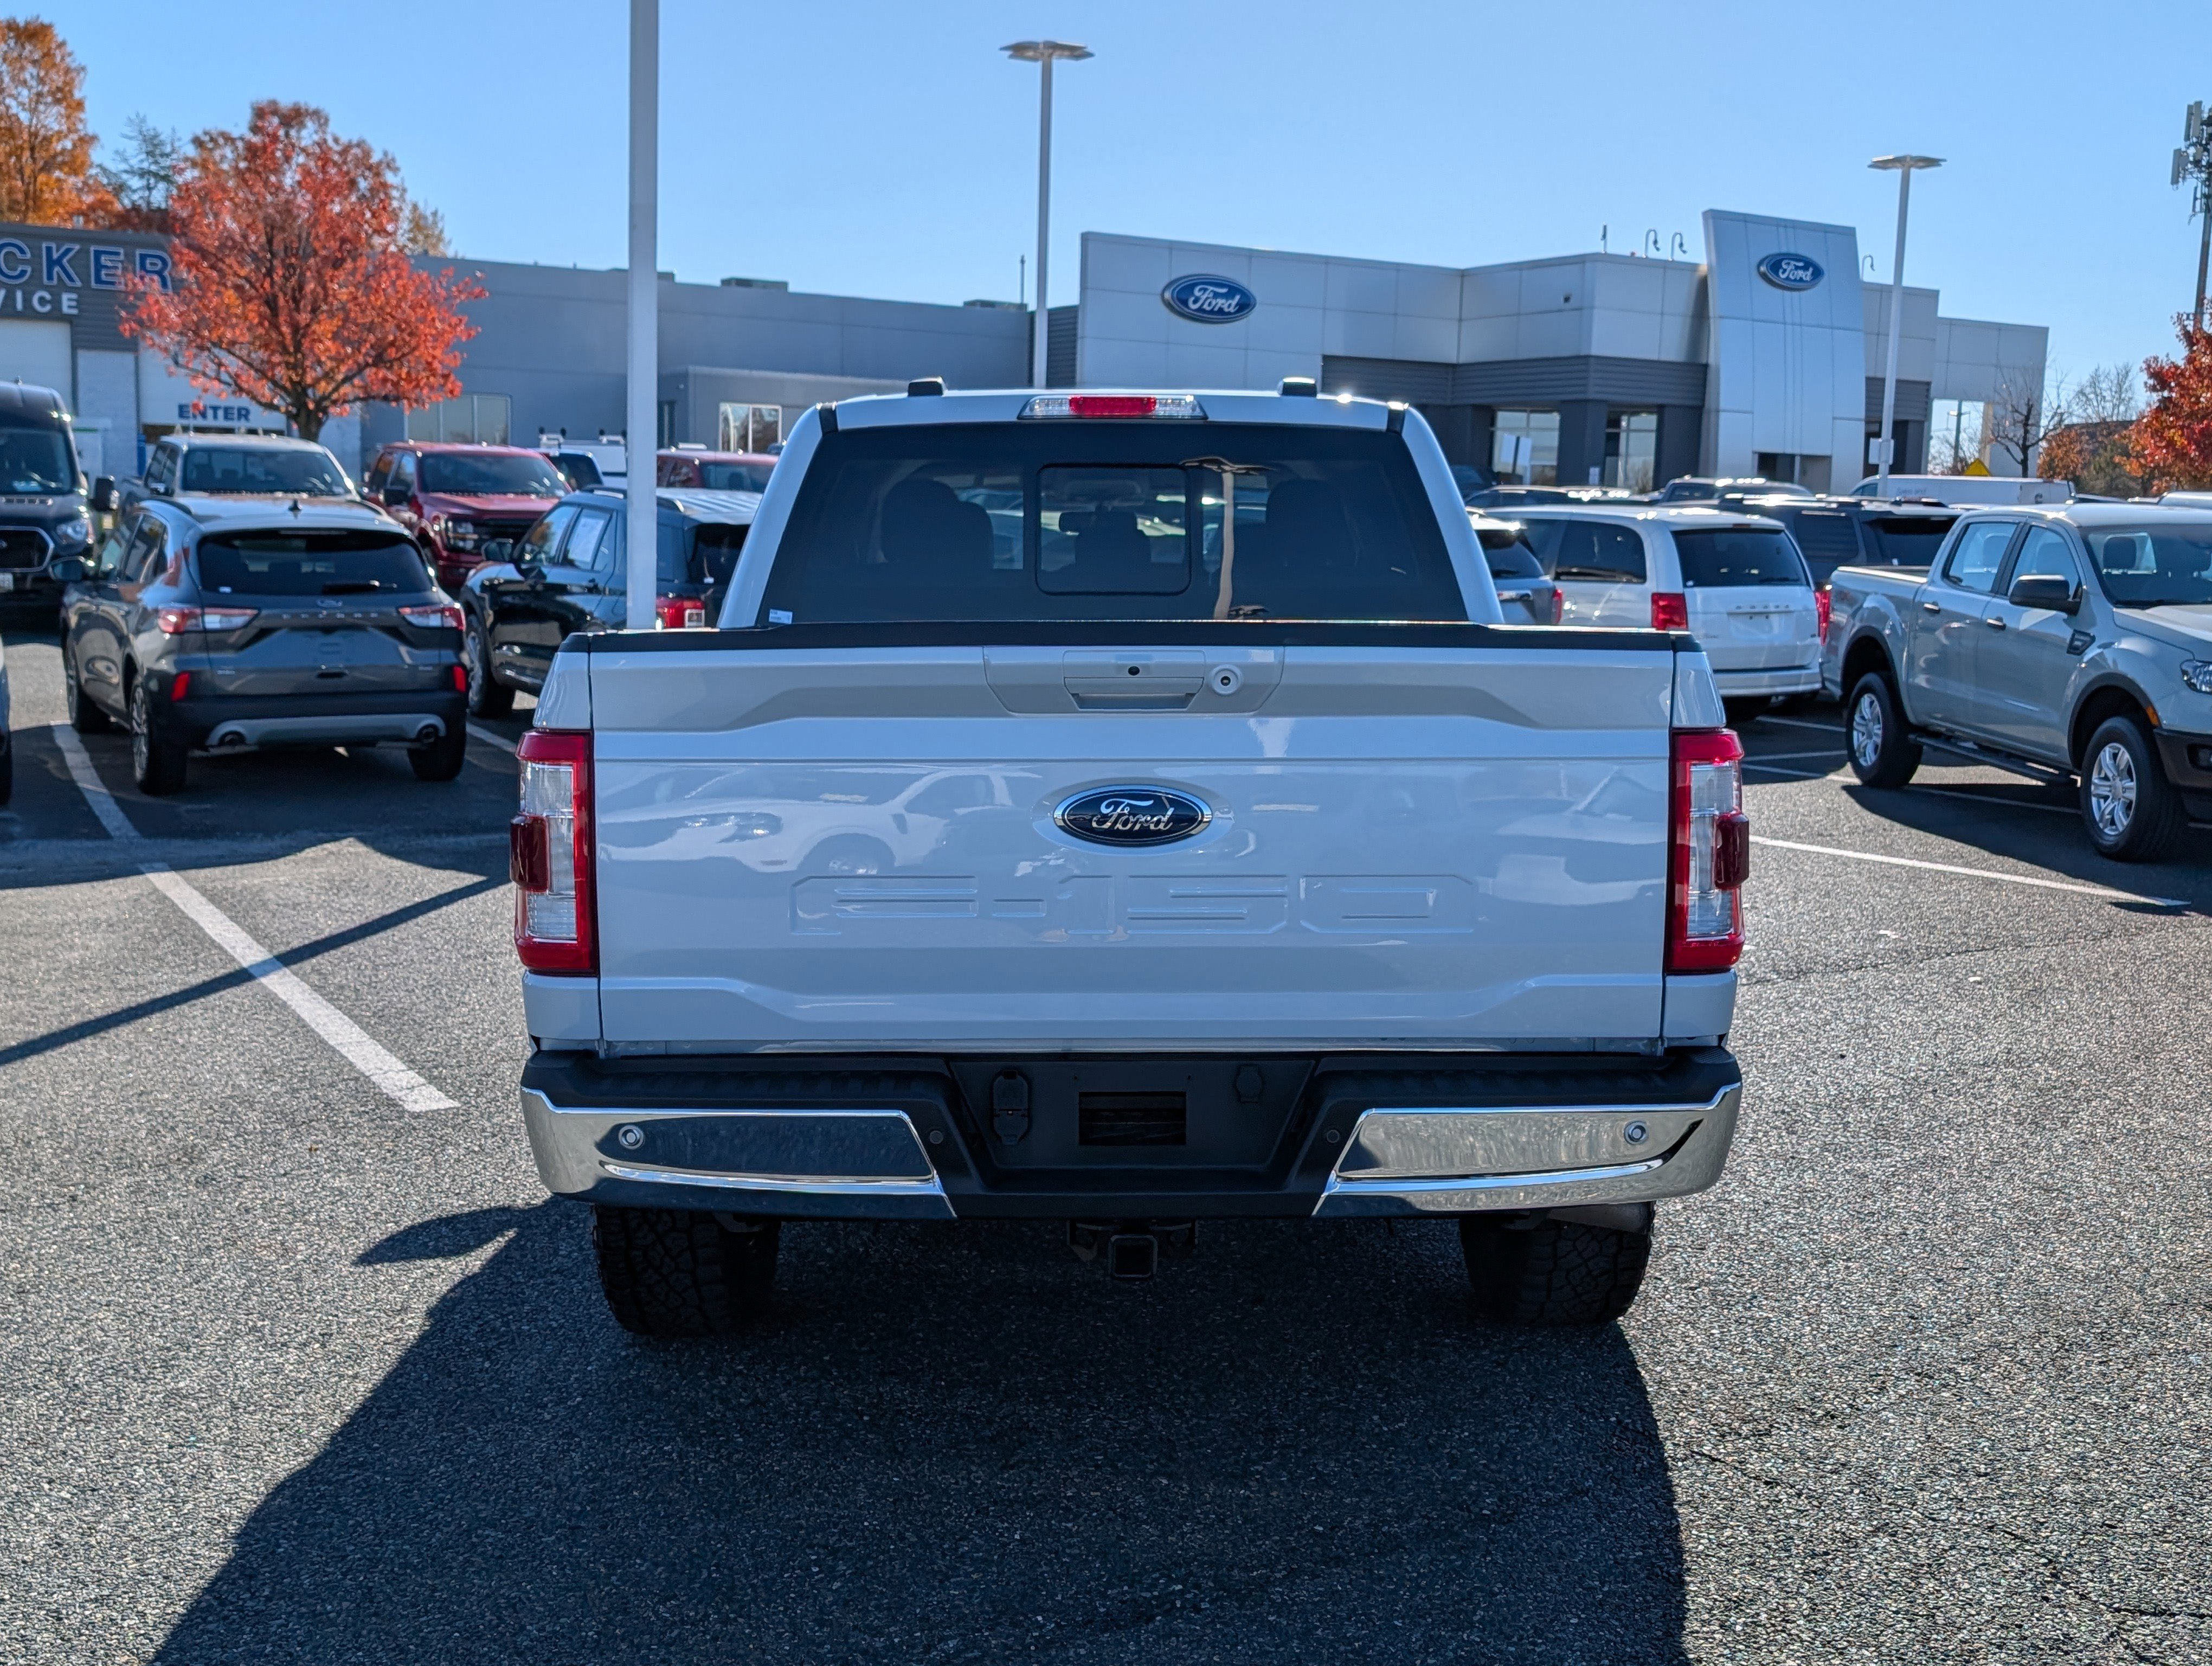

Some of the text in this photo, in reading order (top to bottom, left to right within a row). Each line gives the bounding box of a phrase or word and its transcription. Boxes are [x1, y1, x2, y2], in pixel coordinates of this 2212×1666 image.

[1779, 259, 1814, 281] Ford
[0, 287, 79, 315] ICE
[1187, 284, 1241, 313] Ford
[1091, 798, 1175, 831] Ford
[788, 875, 1473, 936] F-150
